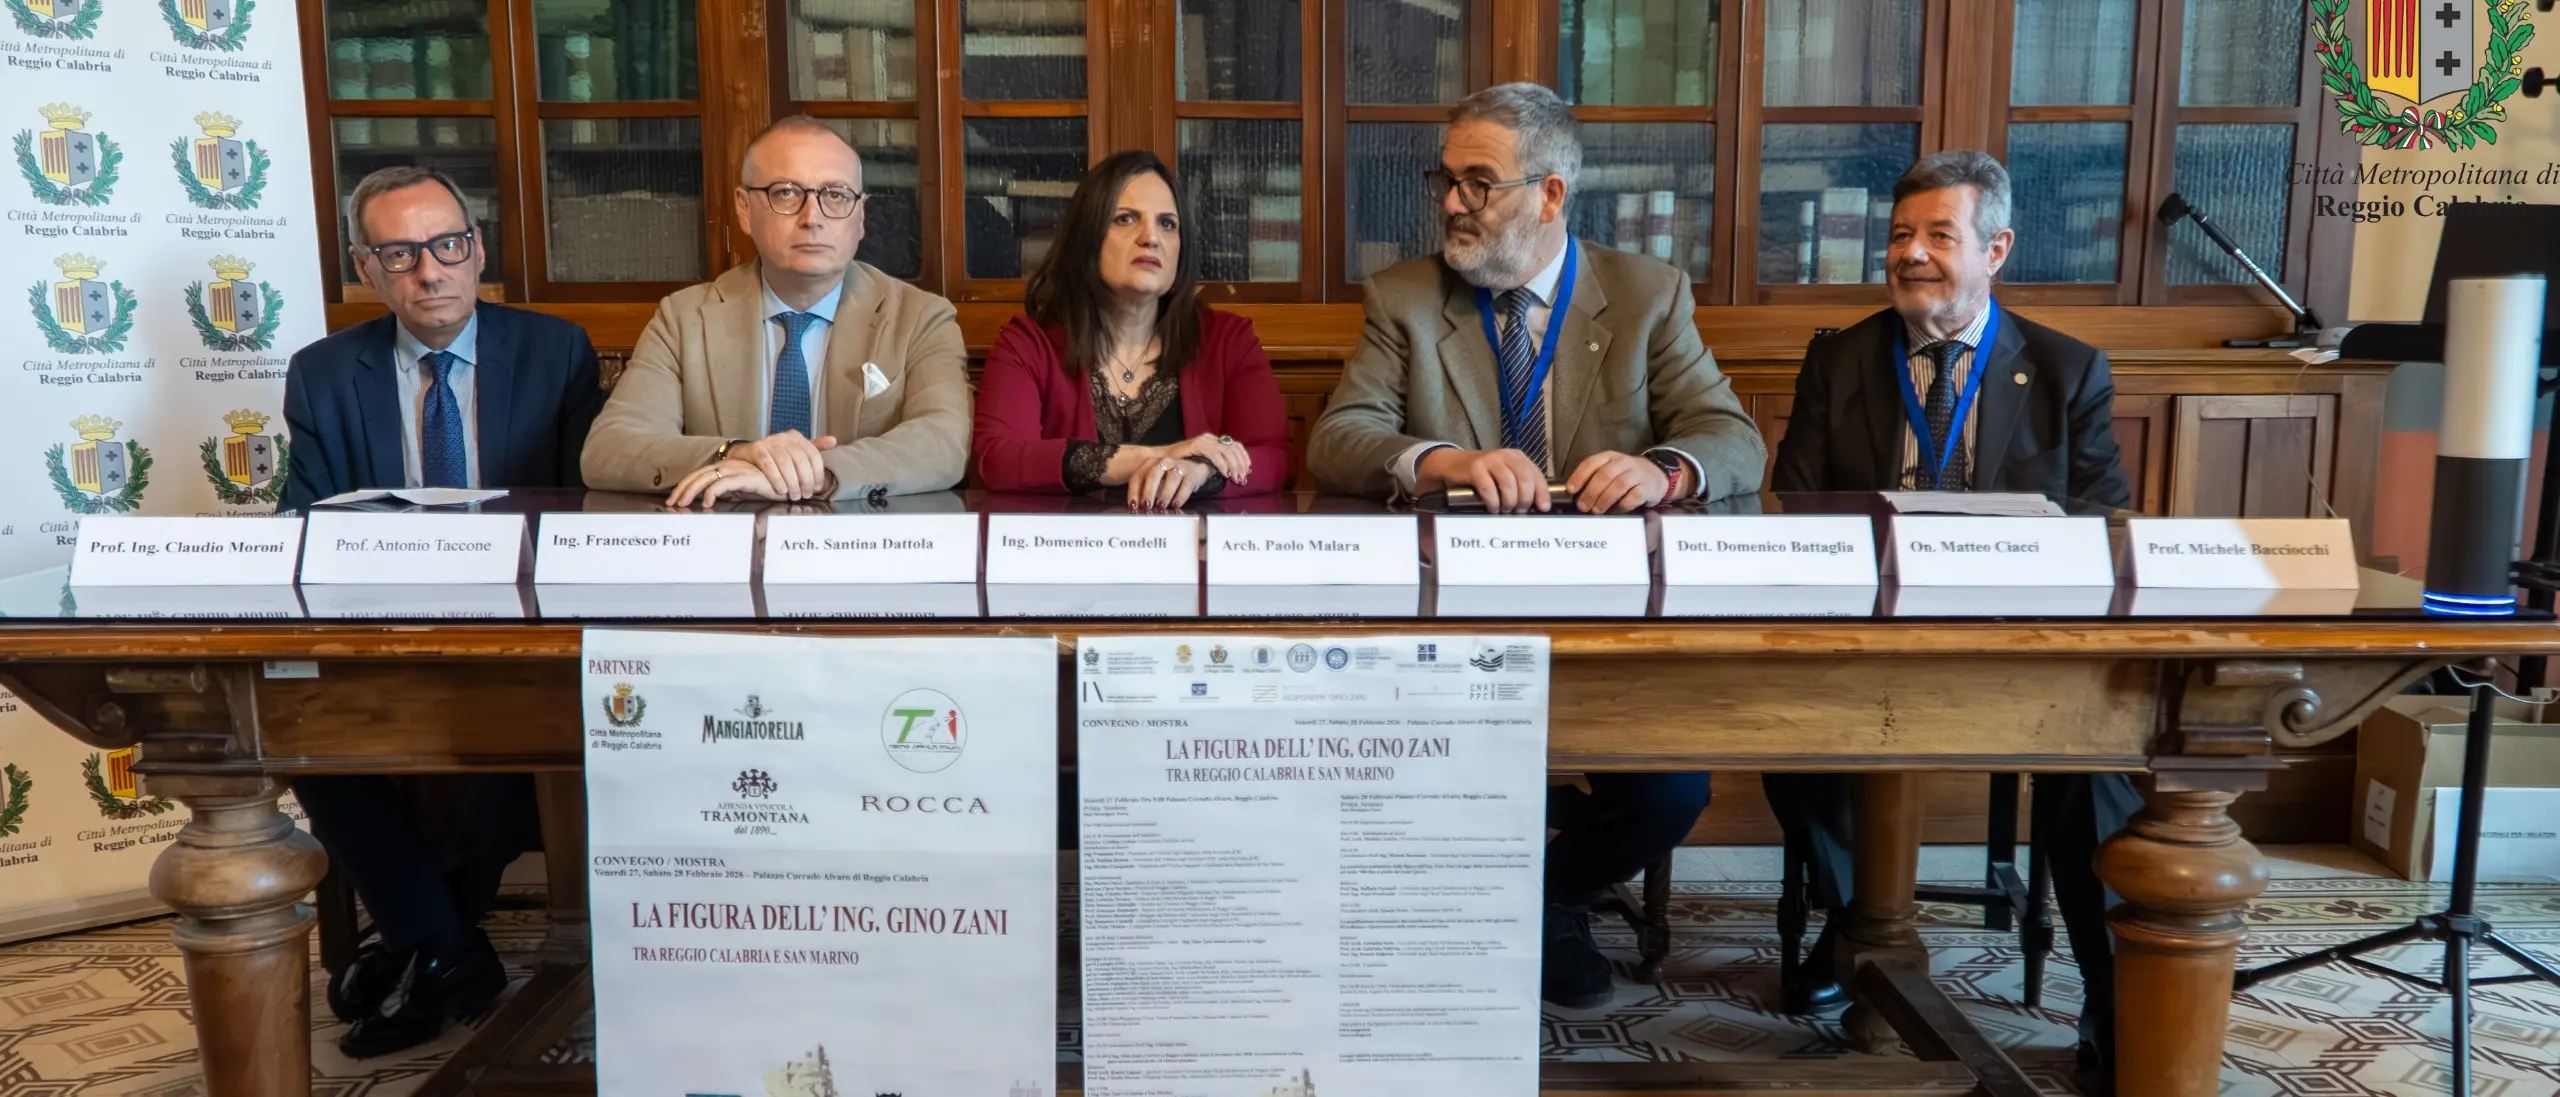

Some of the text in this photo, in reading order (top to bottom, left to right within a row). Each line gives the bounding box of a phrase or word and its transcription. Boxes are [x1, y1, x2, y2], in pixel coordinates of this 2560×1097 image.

[0, 41, 125, 59] ittà Metropolitana di
[8, 55, 112, 72] Reggio Calabria
[149, 51, 272, 70] Città Metropolitana di
[165, 66, 260, 82] Reggio Calabria
[7, 210, 142, 224] Città Metropolitana di
[165, 213, 287, 227] Città Metropolitana di
[24, 224, 128, 238] Reggio Calabria
[181, 227, 275, 240] Reggio Calabria
[22, 358, 156, 371] Città Metropolitana di
[179, 356, 286, 368] Città Metropolitana
[39, 373, 142, 386] Reggio Calabria
[195, 370, 235, 382] Reggio
[2, 525, 14, 536] di
[40, 521, 69, 533] Città
[91, 541, 285, 556] Prof. Ing. Claudio Moroni
[336, 539, 492, 552] Prof. Antonio Taccone
[553, 535, 690, 549] Ing. Francesco Foti
[780, 538, 934, 550] Arch. Santina Dattola
[1002, 535, 1167, 550] Ing. Domenico Condelli
[1222, 540, 1360, 552] Arch. Paolo Malara
[1450, 537, 1608, 549] Dott. Carmelo Versace
[1678, 540, 1854, 555] Dott. Domenico Battaglia
[1910, 541, 2040, 553] On. Matteo Ciacci
[2148, 543, 2330, 557] Prof. Michele Bacciocchi
[589, 660, 651, 675] PARTNERS
[702, 715, 804, 743] MANGIATORELLA
[1082, 719, 1140, 728] CONVEGNO
[1147, 719, 1189, 728] MOSTRA
[609, 730, 661, 739] Metropolitana
[600, 741, 628, 751] Reggio
[630, 741, 661, 750] Calabria
[1165, 740, 1189, 760] LA
[1193, 739, 1260, 760] FIGURA
[1318, 738, 1354, 759] ING.
[1358, 738, 1404, 759] GINO
[1408, 738, 1451, 758] ZANI
[1166, 767, 1394, 782] TRA REGGIO CALABRIA E SAN MARINO
[861, 795, 990, 814] ROCCA
[701, 810, 810, 824] TRAMONTANA
[77, 818, 190, 841] Città Metropolitana
[40, 836, 52, 847] di
[93, 831, 180, 852] Reggio Calab
[594, 856, 664, 867] CONVEGNO
[674, 857, 726, 868] MOSTRA
[643, 869, 672, 877] Sabato
[674, 870, 684, 878] 28
[686, 870, 722, 878] Febbraio
[725, 870, 744, 879] 2026
[753, 871, 784, 880] Palazzo
[786, 872, 821, 881] Corrado
[823, 873, 851, 881] Alvaro
[853, 873, 861, 881] di
[863, 874, 891, 884] Reggio
[893, 875, 929, 883] Calabria
[631, 902, 663, 929] LA
[668, 903, 756, 931] FIGURA
[833, 906, 880, 933] ING.
[887, 907, 946, 935] GINO
[953, 909, 1008, 936] ZANI
[633, 946, 860, 966] TRA REGGIO CALABRIA E SAN MARINO
